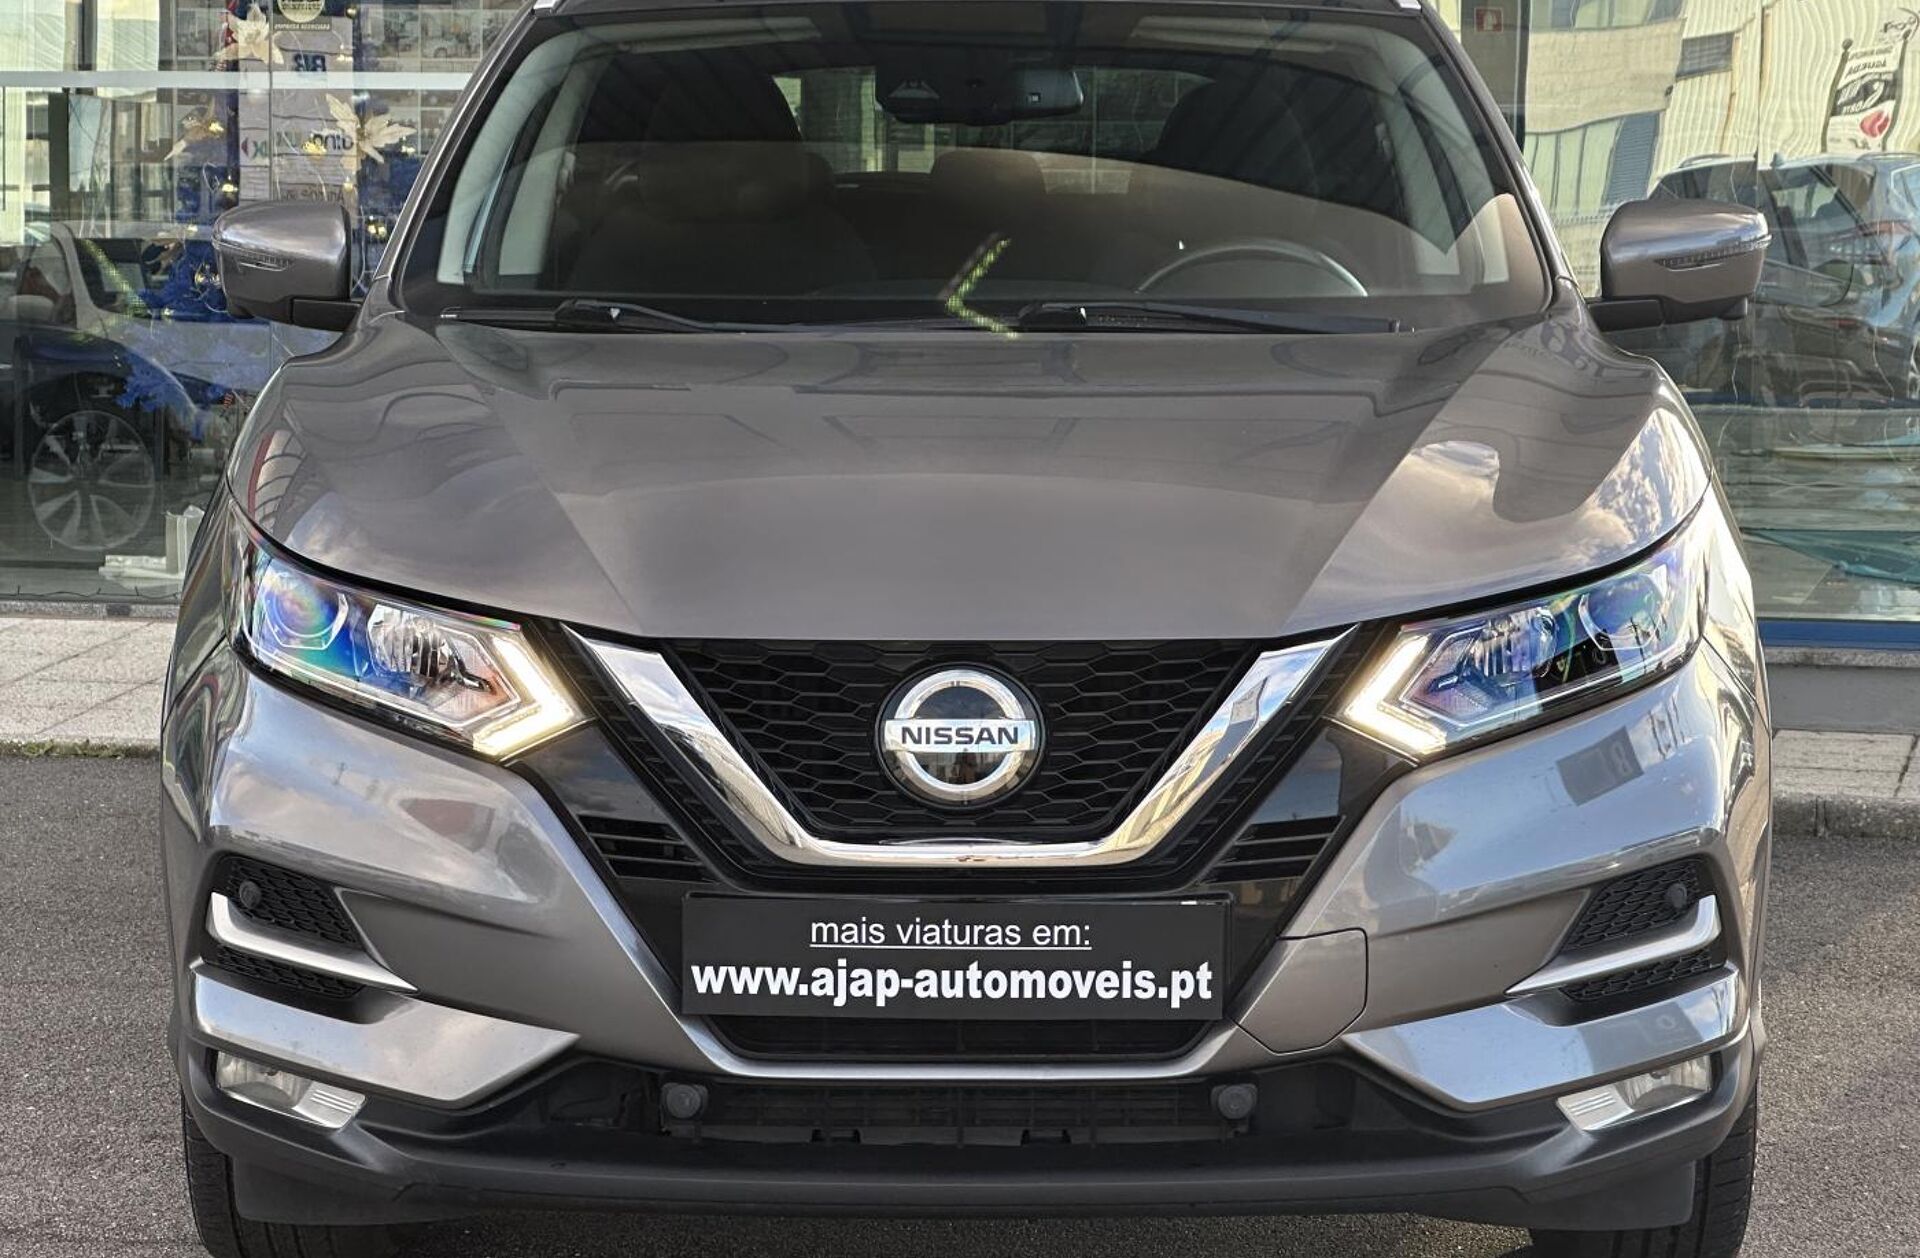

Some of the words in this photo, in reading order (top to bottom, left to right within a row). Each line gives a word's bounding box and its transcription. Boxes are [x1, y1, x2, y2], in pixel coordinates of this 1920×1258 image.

[901, 726, 1019, 745] NISSAN
[811, 917, 886, 944] mais
[896, 917, 1022, 946] viaturas
[1032, 924, 1091, 946] em:
[690, 958, 1213, 1009] www.ajap-automoveis.pt
